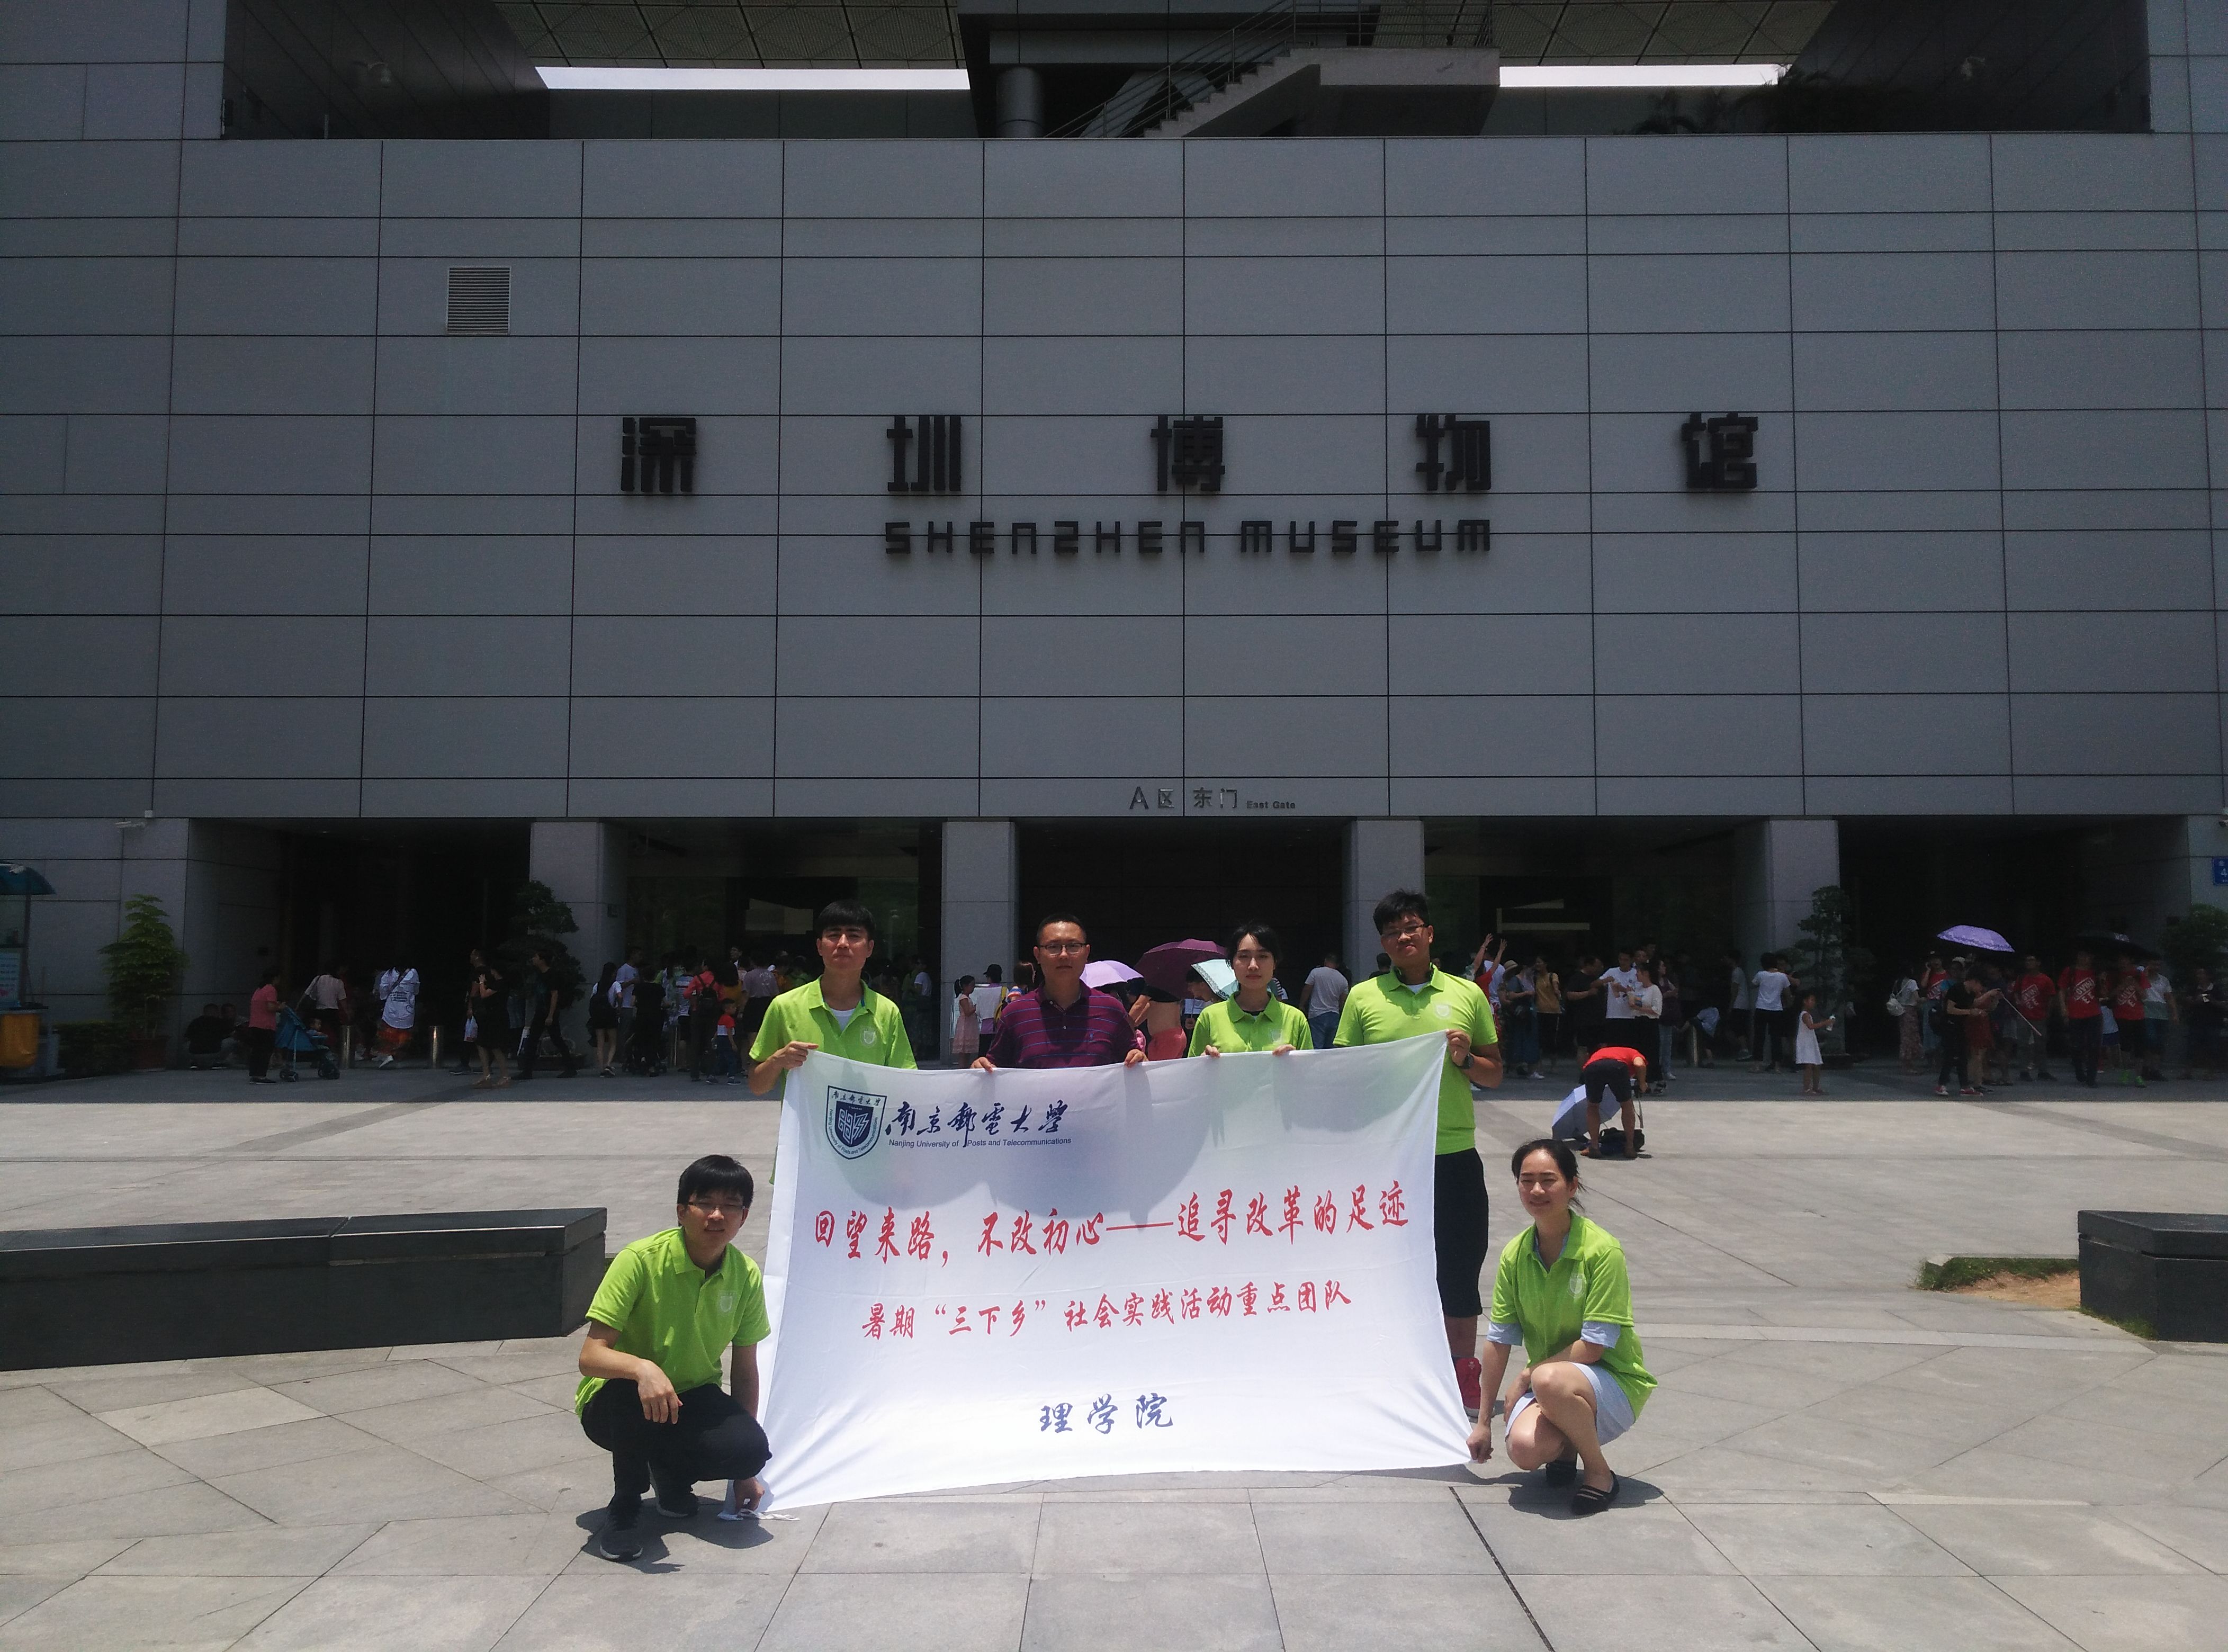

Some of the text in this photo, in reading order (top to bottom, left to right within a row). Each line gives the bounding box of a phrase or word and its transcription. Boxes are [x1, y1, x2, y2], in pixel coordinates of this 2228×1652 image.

[1240, 519, 1490, 553] MUSEUM
[1193, 787, 1237, 809] 东门
[1246, 801, 1269, 809] East
[1272, 801, 1296, 809] Gate
[889, 1139, 914, 1148] Nanjing
[917, 1140, 950, 1148] University
[1039, 1393, 1173, 1434] 理学院
